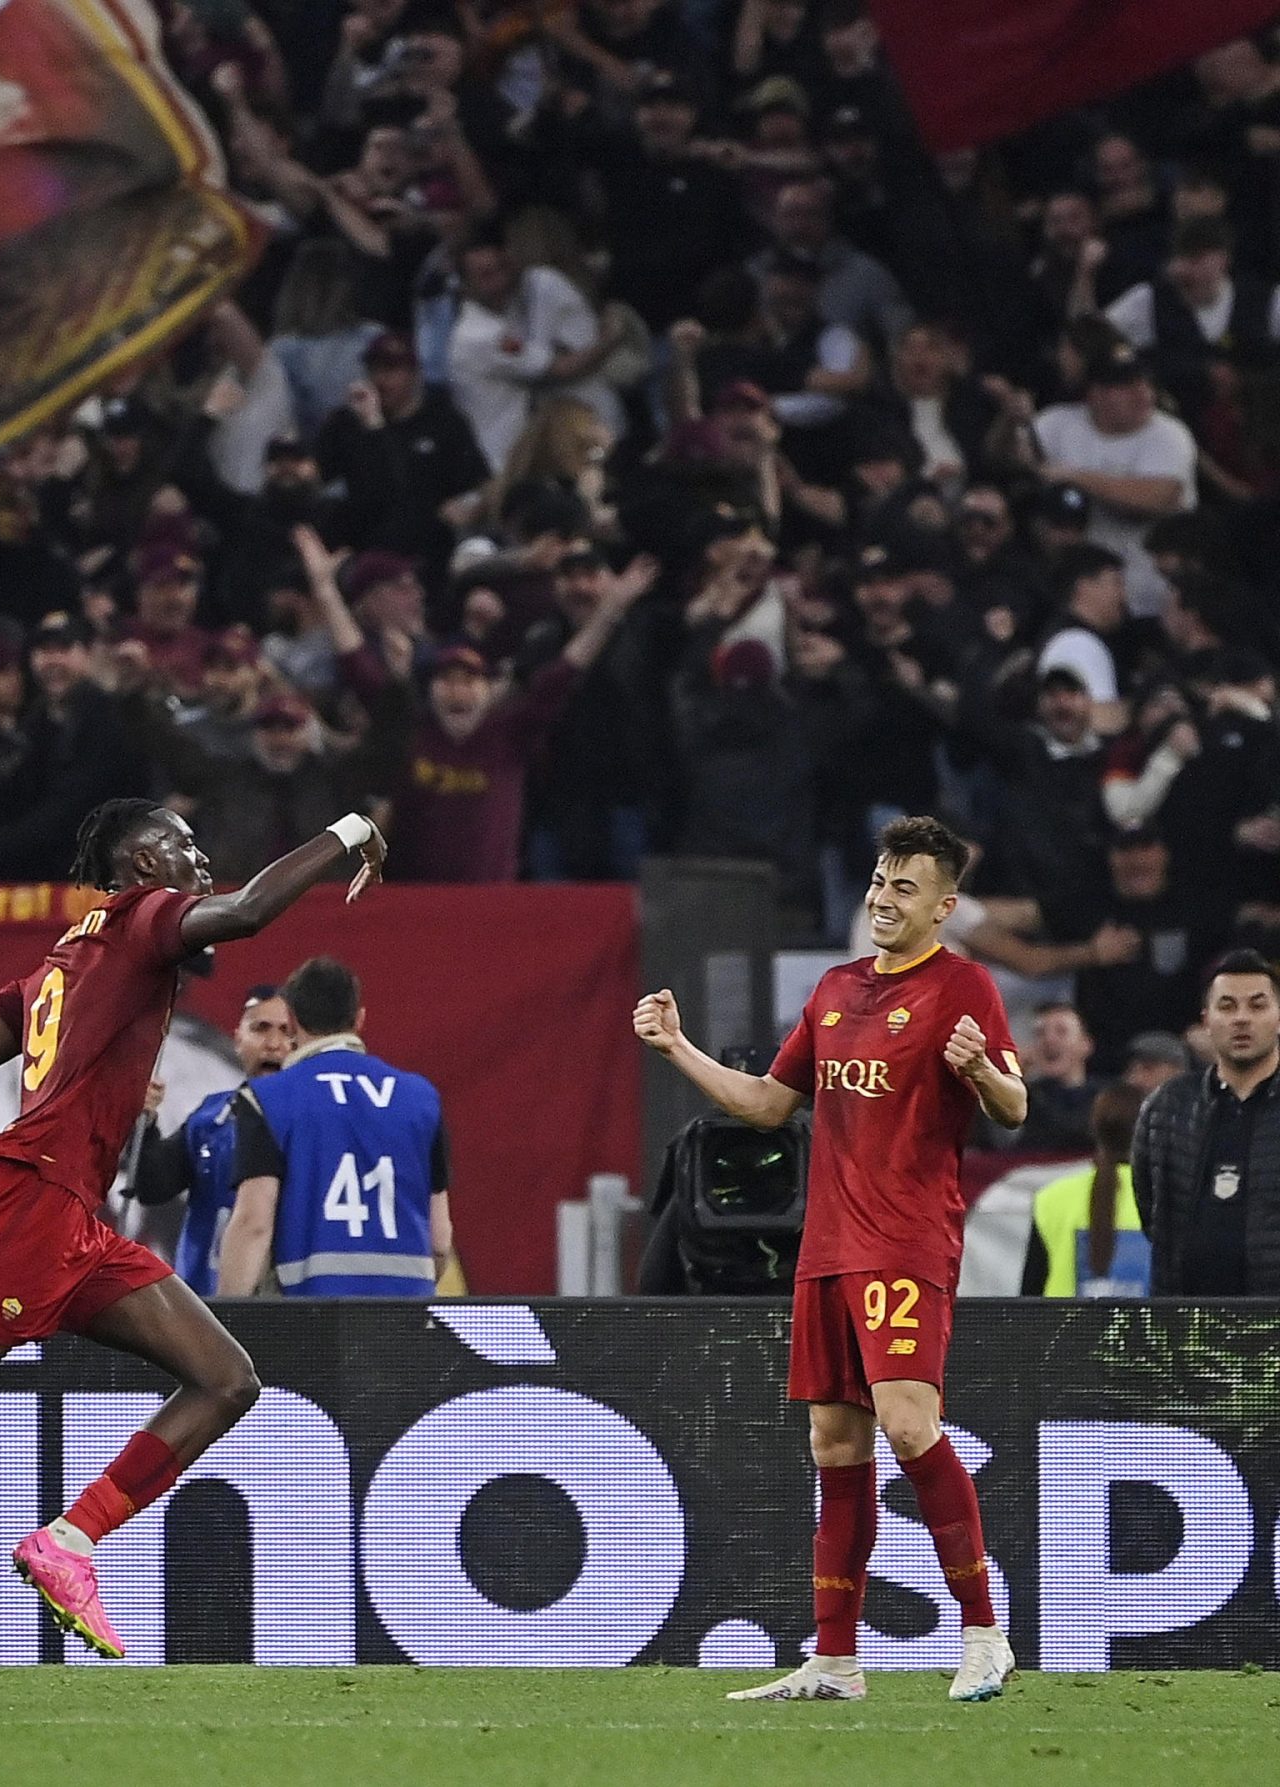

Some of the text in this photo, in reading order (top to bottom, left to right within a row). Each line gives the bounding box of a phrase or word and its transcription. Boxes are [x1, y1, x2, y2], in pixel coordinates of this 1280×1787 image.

[23, 966, 64, 1092] 9
[315, 1072, 396, 1108] TV
[323, 1152, 398, 1239] 41
[863, 1278, 921, 1332] 92
